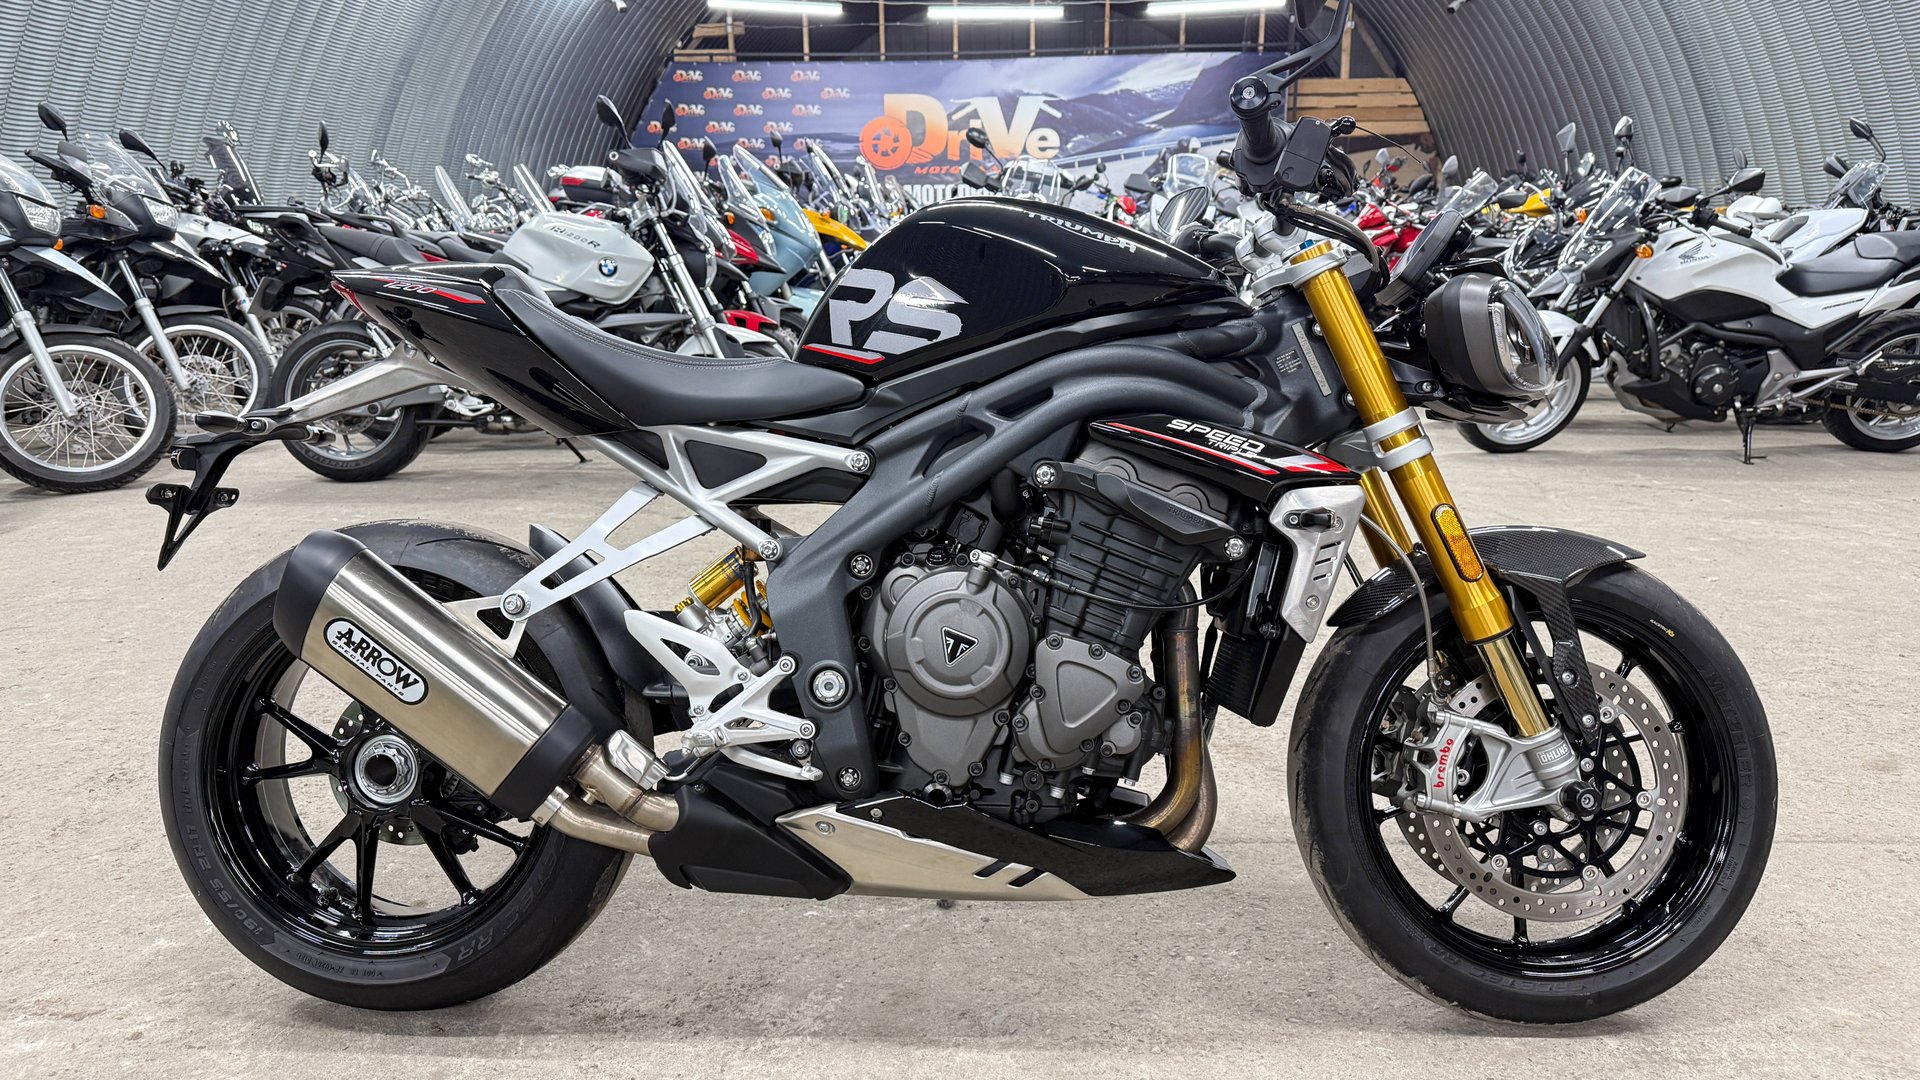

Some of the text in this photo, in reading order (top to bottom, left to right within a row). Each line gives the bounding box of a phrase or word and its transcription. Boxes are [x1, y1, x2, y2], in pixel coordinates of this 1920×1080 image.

[1024, 211, 1137, 253] TRIUMPH
[383, 281, 438, 294] 1200
[829, 268, 969, 355] RS
[1166, 419, 1265, 453] SPEED
[1168, 505, 1205, 527] TRIUMPH
[332, 640, 405, 697] SPECIAL PARTS
[336, 627, 420, 690] ARROW
[1433, 738, 1454, 789] brembo
[1540, 743, 1569, 763] ÖHLINS
